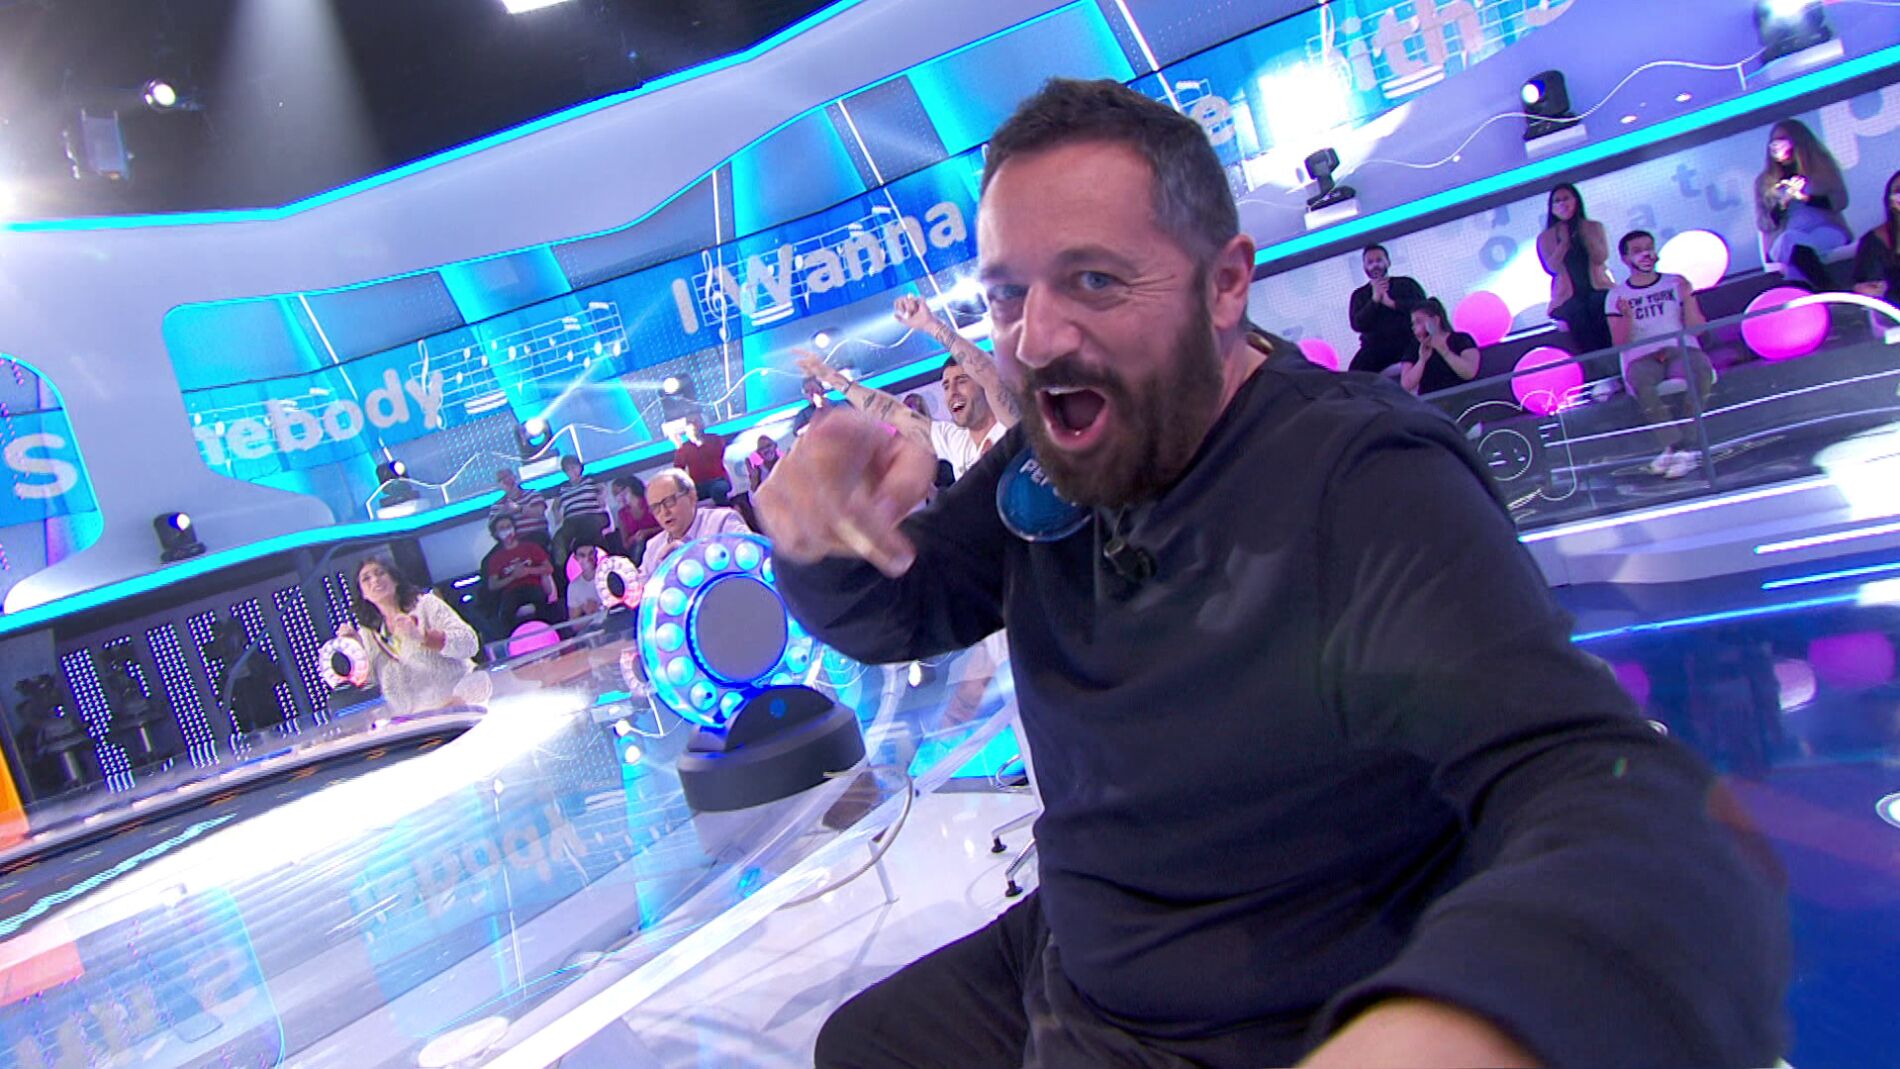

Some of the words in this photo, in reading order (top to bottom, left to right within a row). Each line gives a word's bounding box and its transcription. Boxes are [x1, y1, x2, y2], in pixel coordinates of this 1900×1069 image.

[1343, 0, 1484, 92] ith
[672, 278, 699, 334] I
[712, 201, 968, 312] Wanna
[1646, 288, 1677, 303] YORK
[1635, 304, 1664, 320] CITY
[4, 433, 78, 499] S
